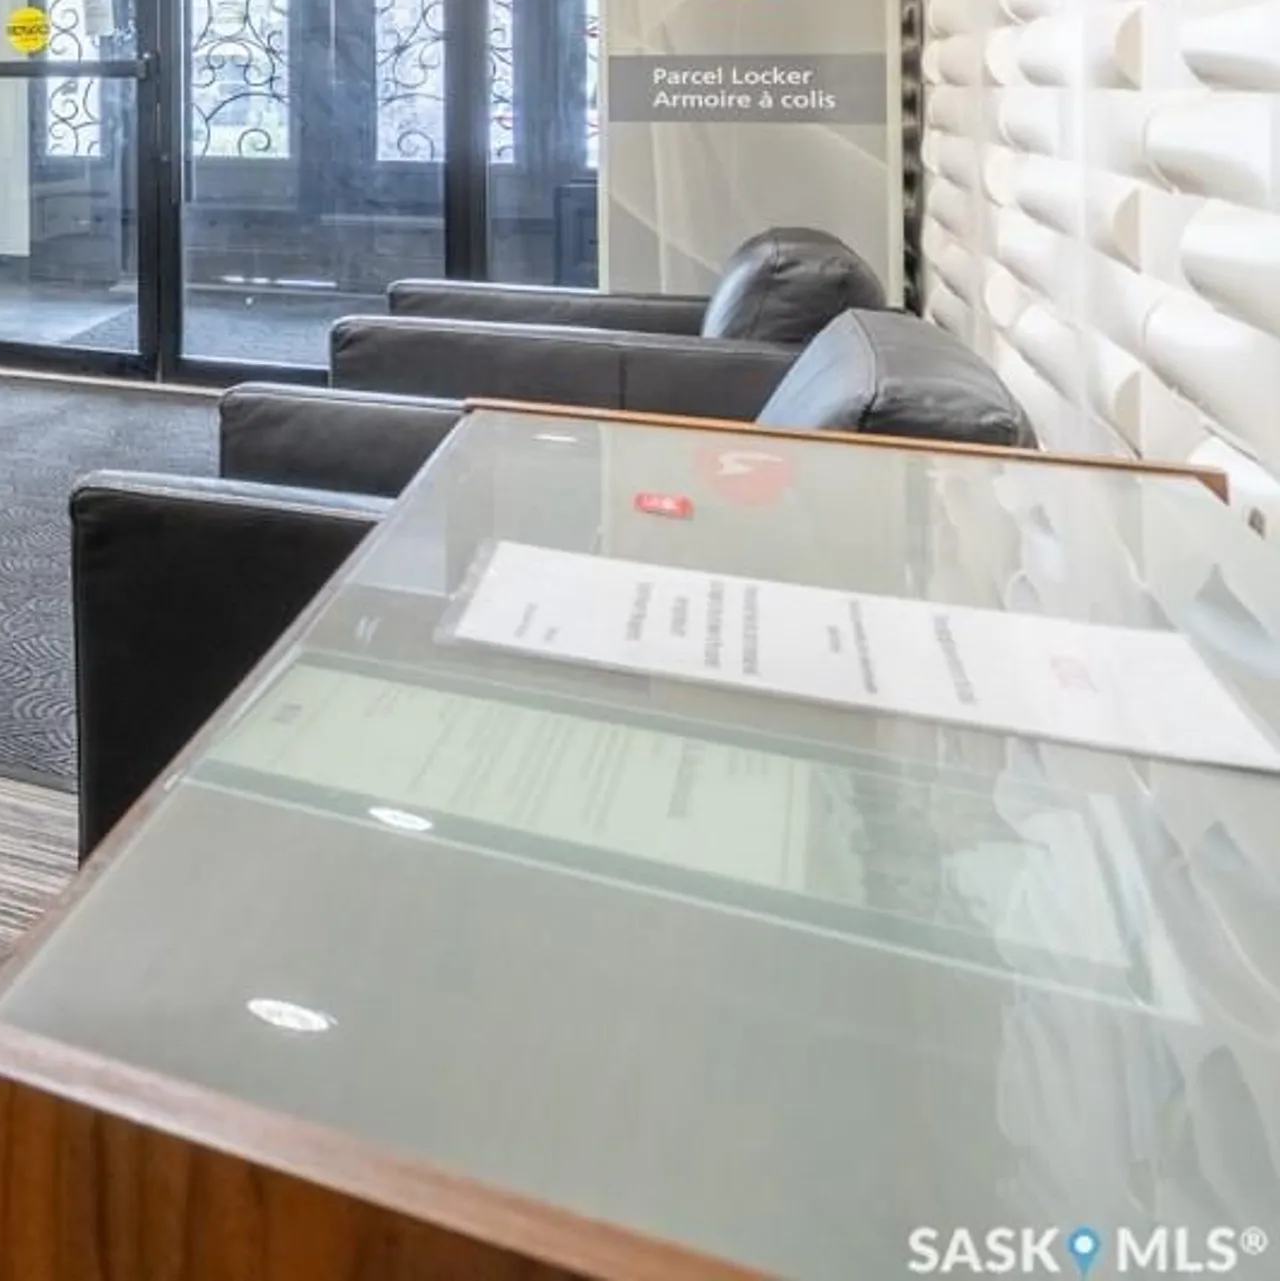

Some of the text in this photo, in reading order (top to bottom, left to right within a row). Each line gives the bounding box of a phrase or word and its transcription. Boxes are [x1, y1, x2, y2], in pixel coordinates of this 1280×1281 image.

[652, 66, 814, 85] Parcel Locker
[652, 89, 836, 109] Armoire à colis
